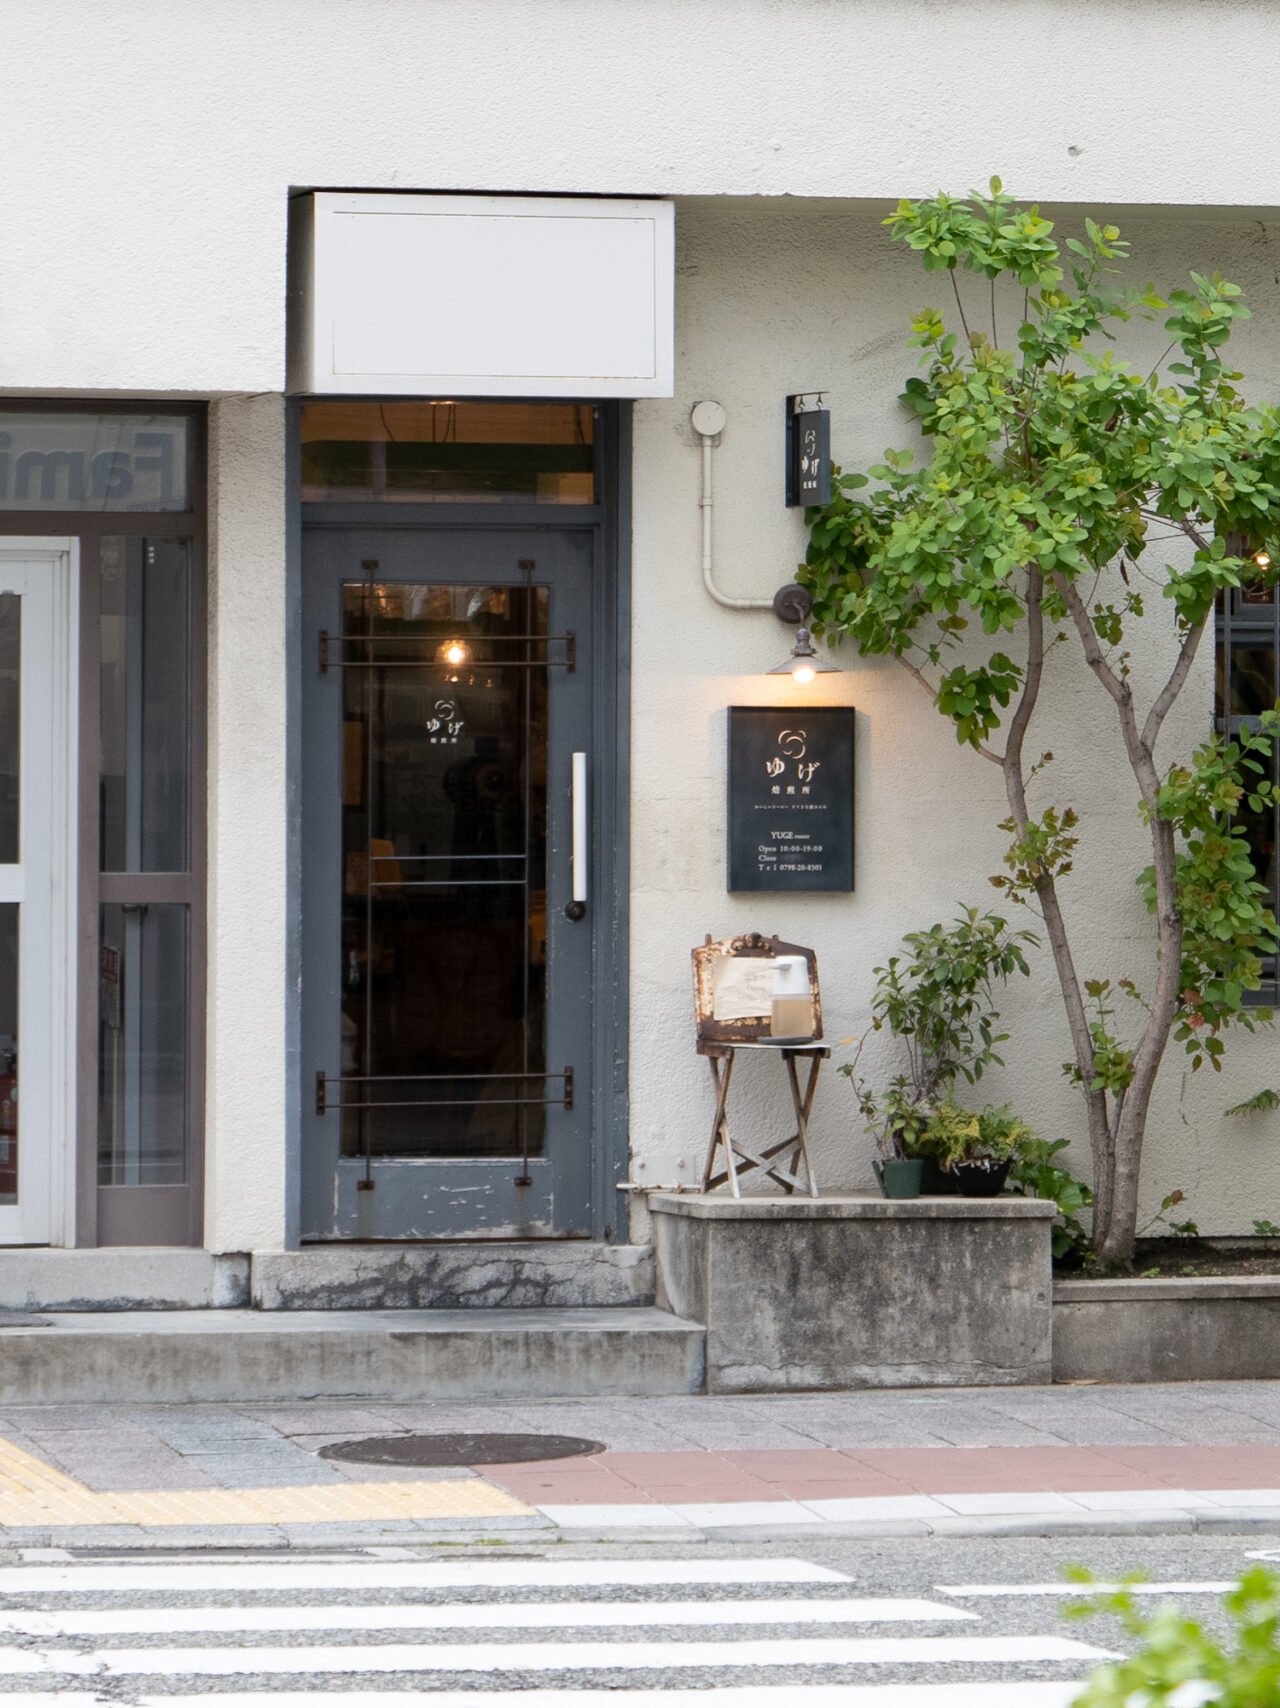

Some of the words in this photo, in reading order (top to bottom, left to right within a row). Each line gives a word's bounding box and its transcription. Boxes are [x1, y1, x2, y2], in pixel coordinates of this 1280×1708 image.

[766, 757, 820, 783] ゆげ
[771, 831, 794, 840] YUGE
[758, 845, 777, 854] Open
